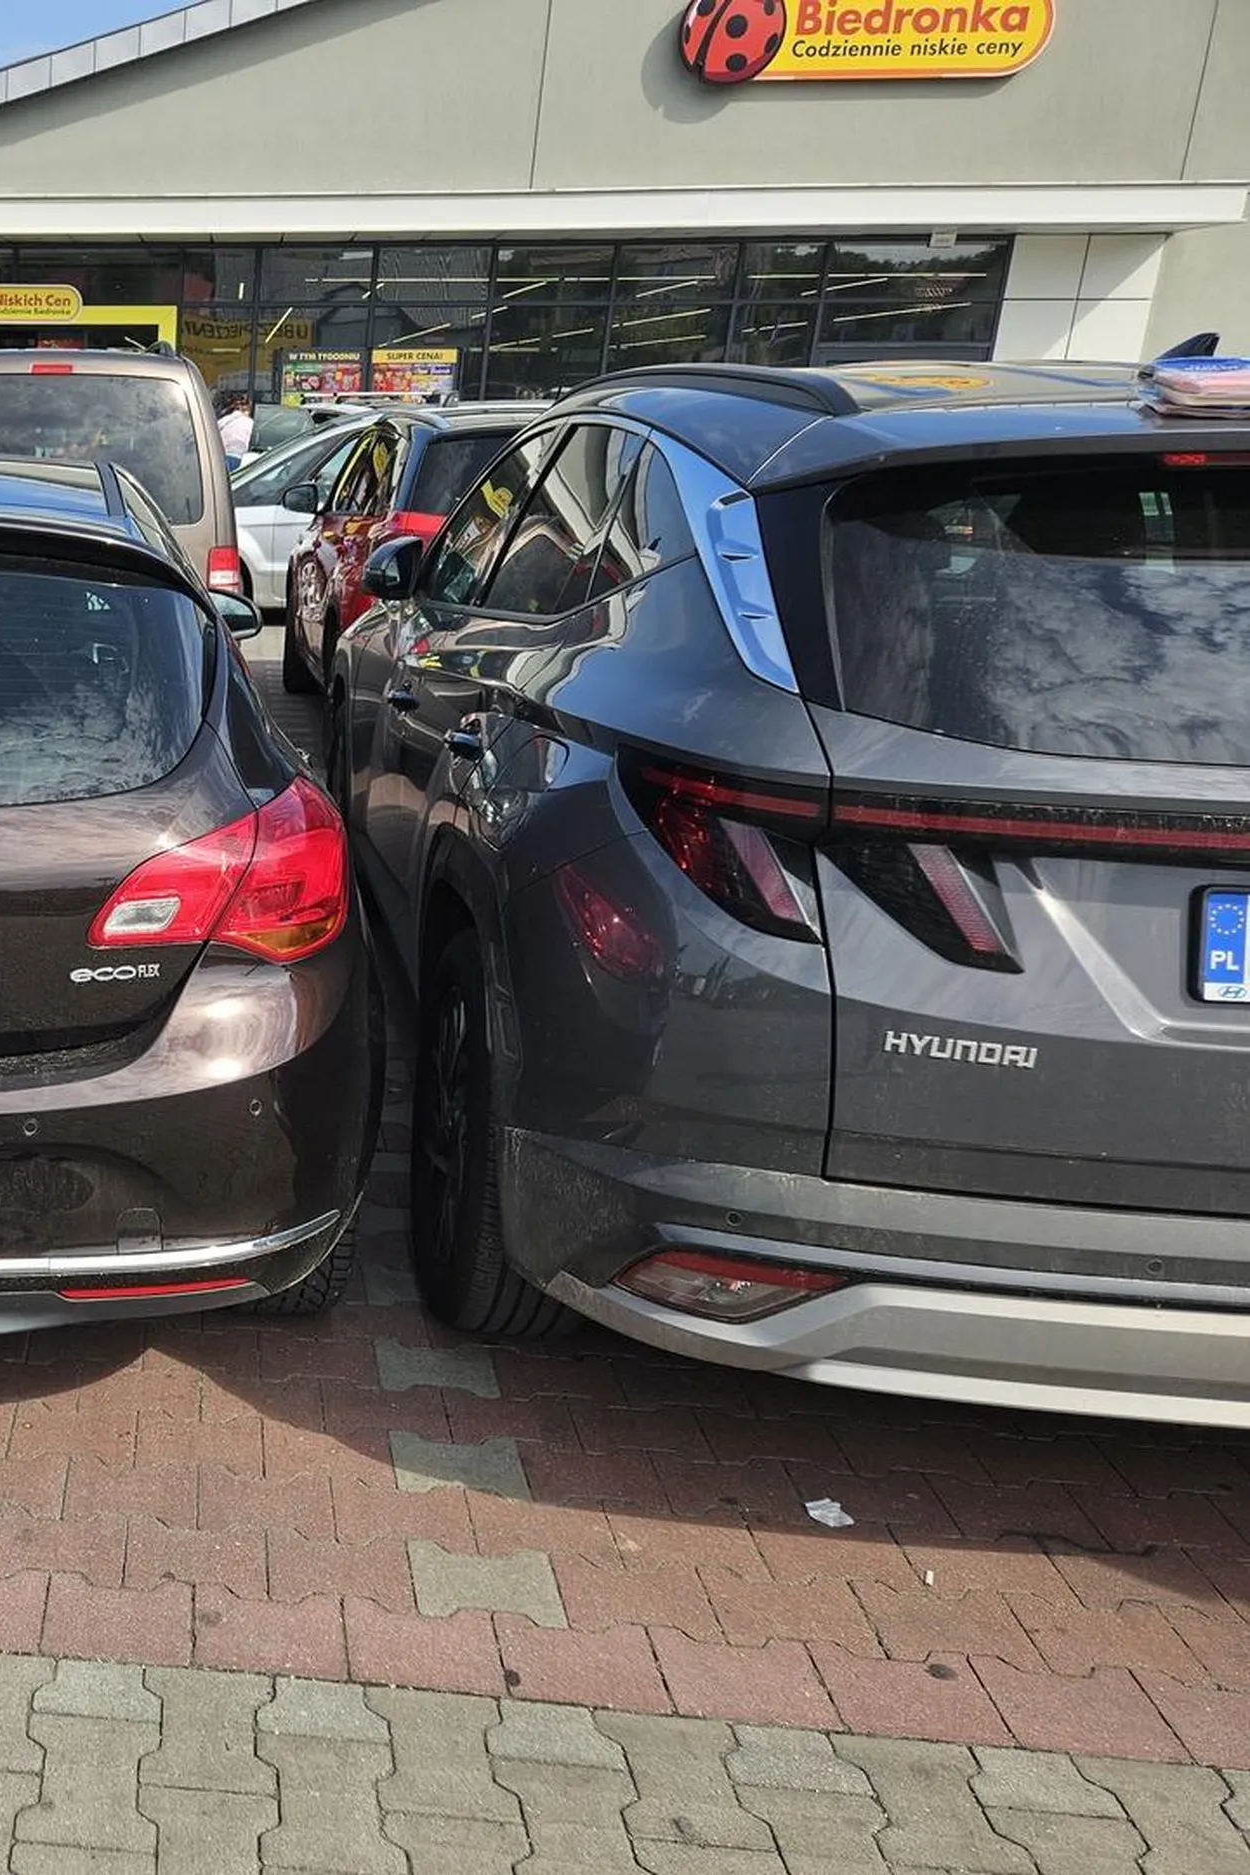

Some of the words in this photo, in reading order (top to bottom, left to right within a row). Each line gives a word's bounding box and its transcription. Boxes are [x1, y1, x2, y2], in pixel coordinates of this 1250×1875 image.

[795, 0, 1030, 36] Biedronka
[792, 39, 901, 57] Codziennie
[910, 38, 967, 56] niskie
[976, 41, 1023, 58] ceny
[45, 293, 70, 306] Cen
[387, 352, 413, 360] SUPER
[416, 352, 443, 360] CENA!
[1210, 950, 1240, 971] PL
[884, 1030, 1038, 1069] HYUNDAI
